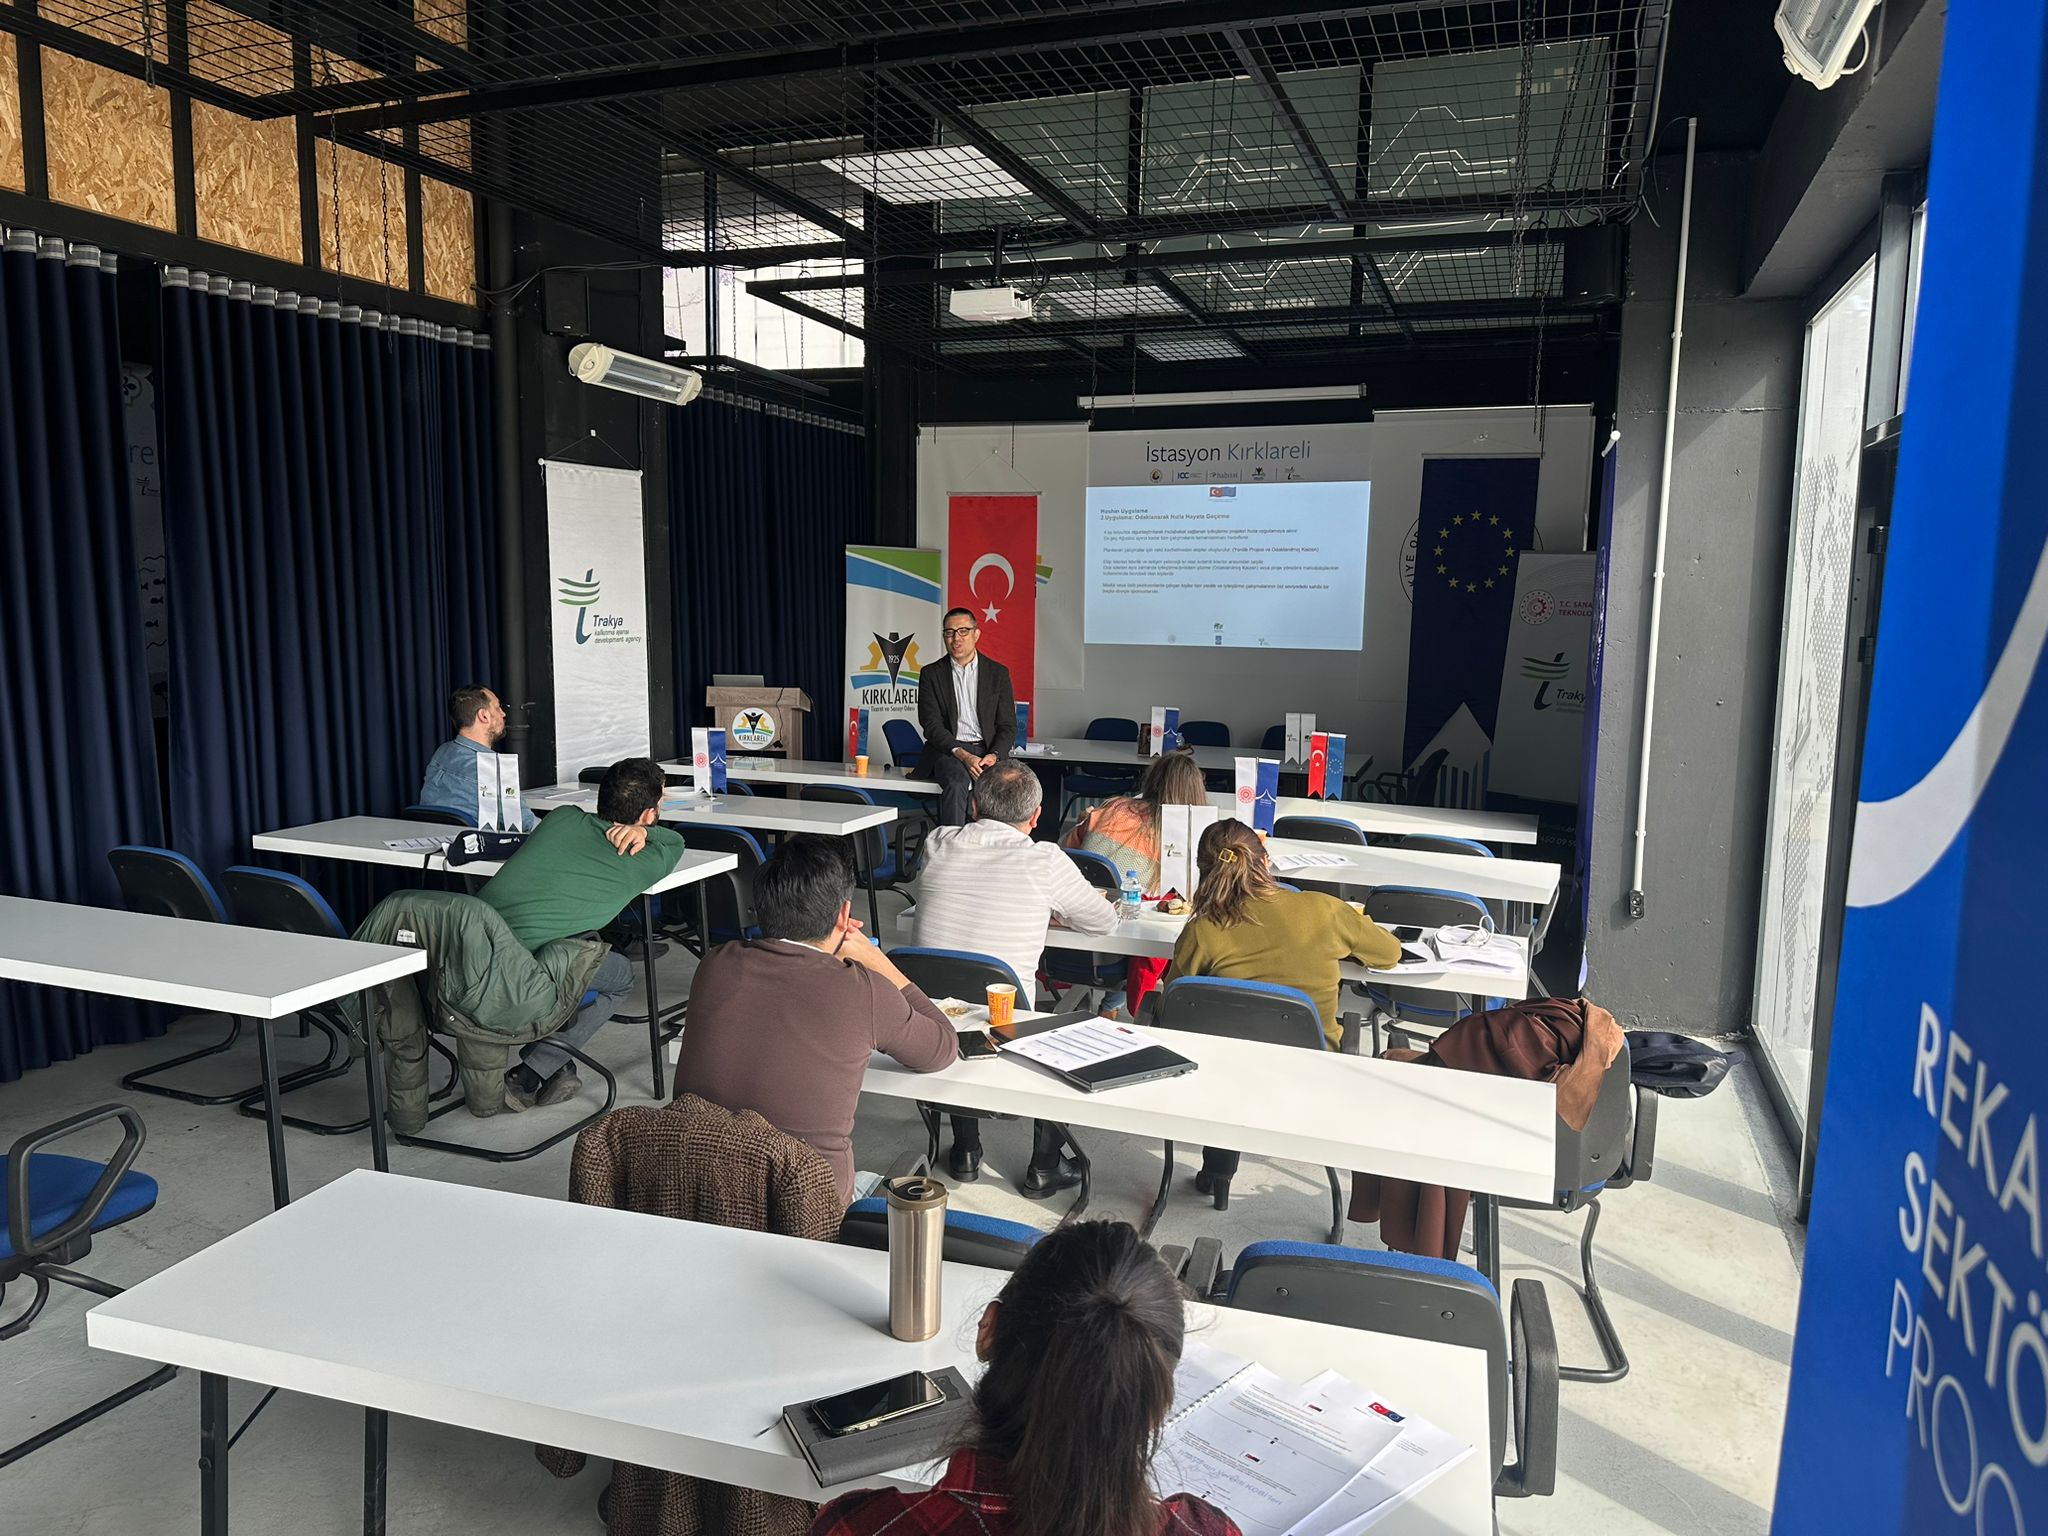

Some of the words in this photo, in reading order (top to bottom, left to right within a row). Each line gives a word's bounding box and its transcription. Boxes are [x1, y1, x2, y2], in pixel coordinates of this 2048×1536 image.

[1146, 441, 1221, 467] İstasyon
[1228, 440, 1311, 461] Kırklareli
[1558, 609, 1592, 617] TEKNOLO
[593, 614, 624, 629] Trakya
[625, 636, 642, 644] agency
[1912, 1001, 2048, 1272] REKA
